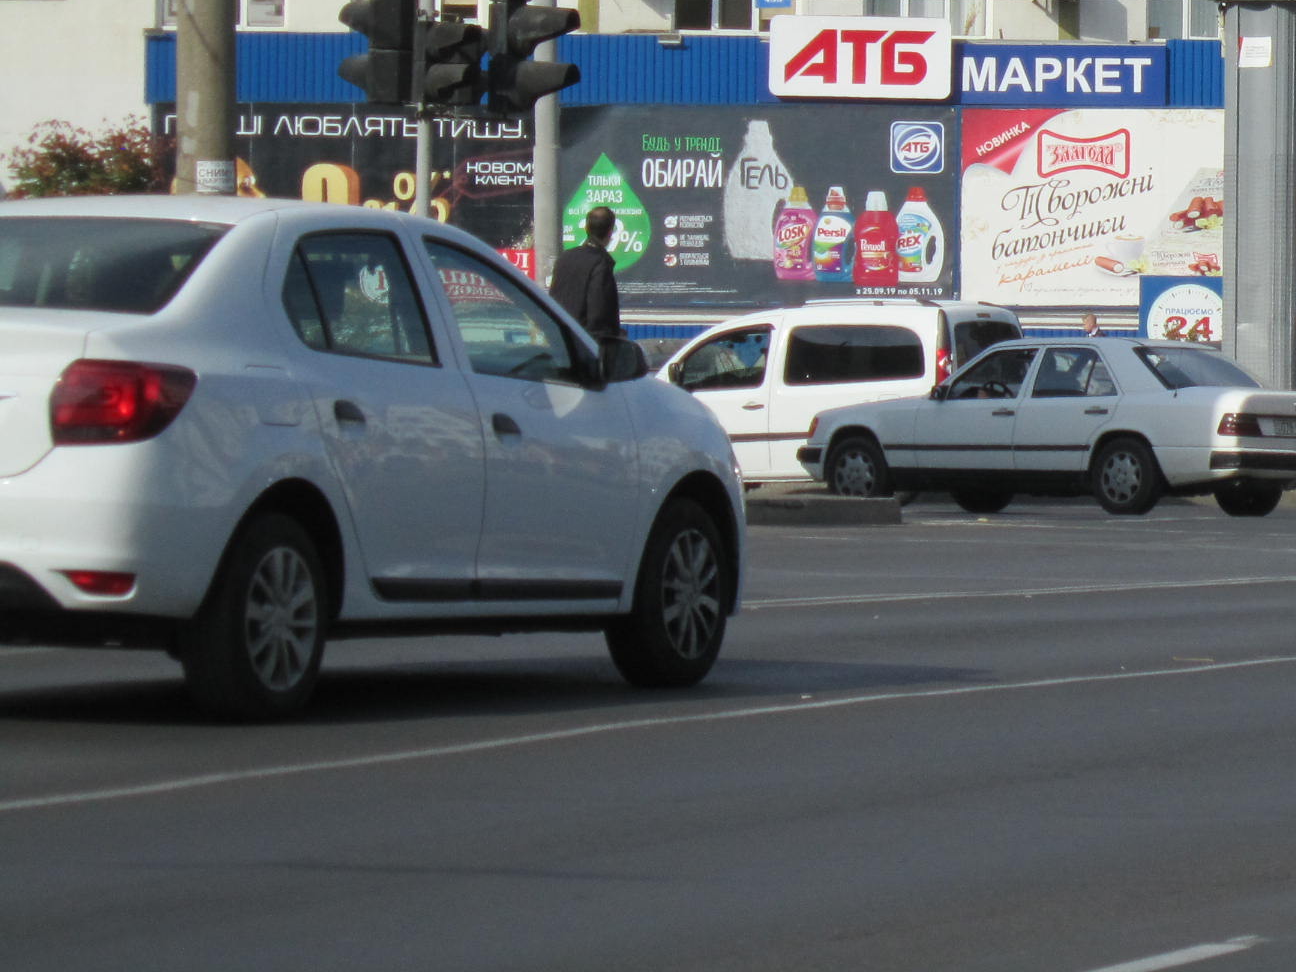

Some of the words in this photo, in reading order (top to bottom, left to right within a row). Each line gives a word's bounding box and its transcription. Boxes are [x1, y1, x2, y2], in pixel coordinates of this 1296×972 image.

[784, 28, 937, 86] АТБ
[961, 56, 1153, 94] МАРКЕТ
[900, 141, 932, 155] АТБ
[975, 121, 1031, 157] НОВИНКА
[642, 152, 723, 188] ОБИРАЙ
[586, 190, 623, 203] ЗАРАЗ
[778, 225, 807, 243] LOSK
[817, 227, 847, 237] Persil
[991, 215, 1127, 261] батончики
[860, 239, 886, 252] Perwoll
[862, 287, 896, 295] 25.09.19
[909, 287, 943, 296] 05.11.19
